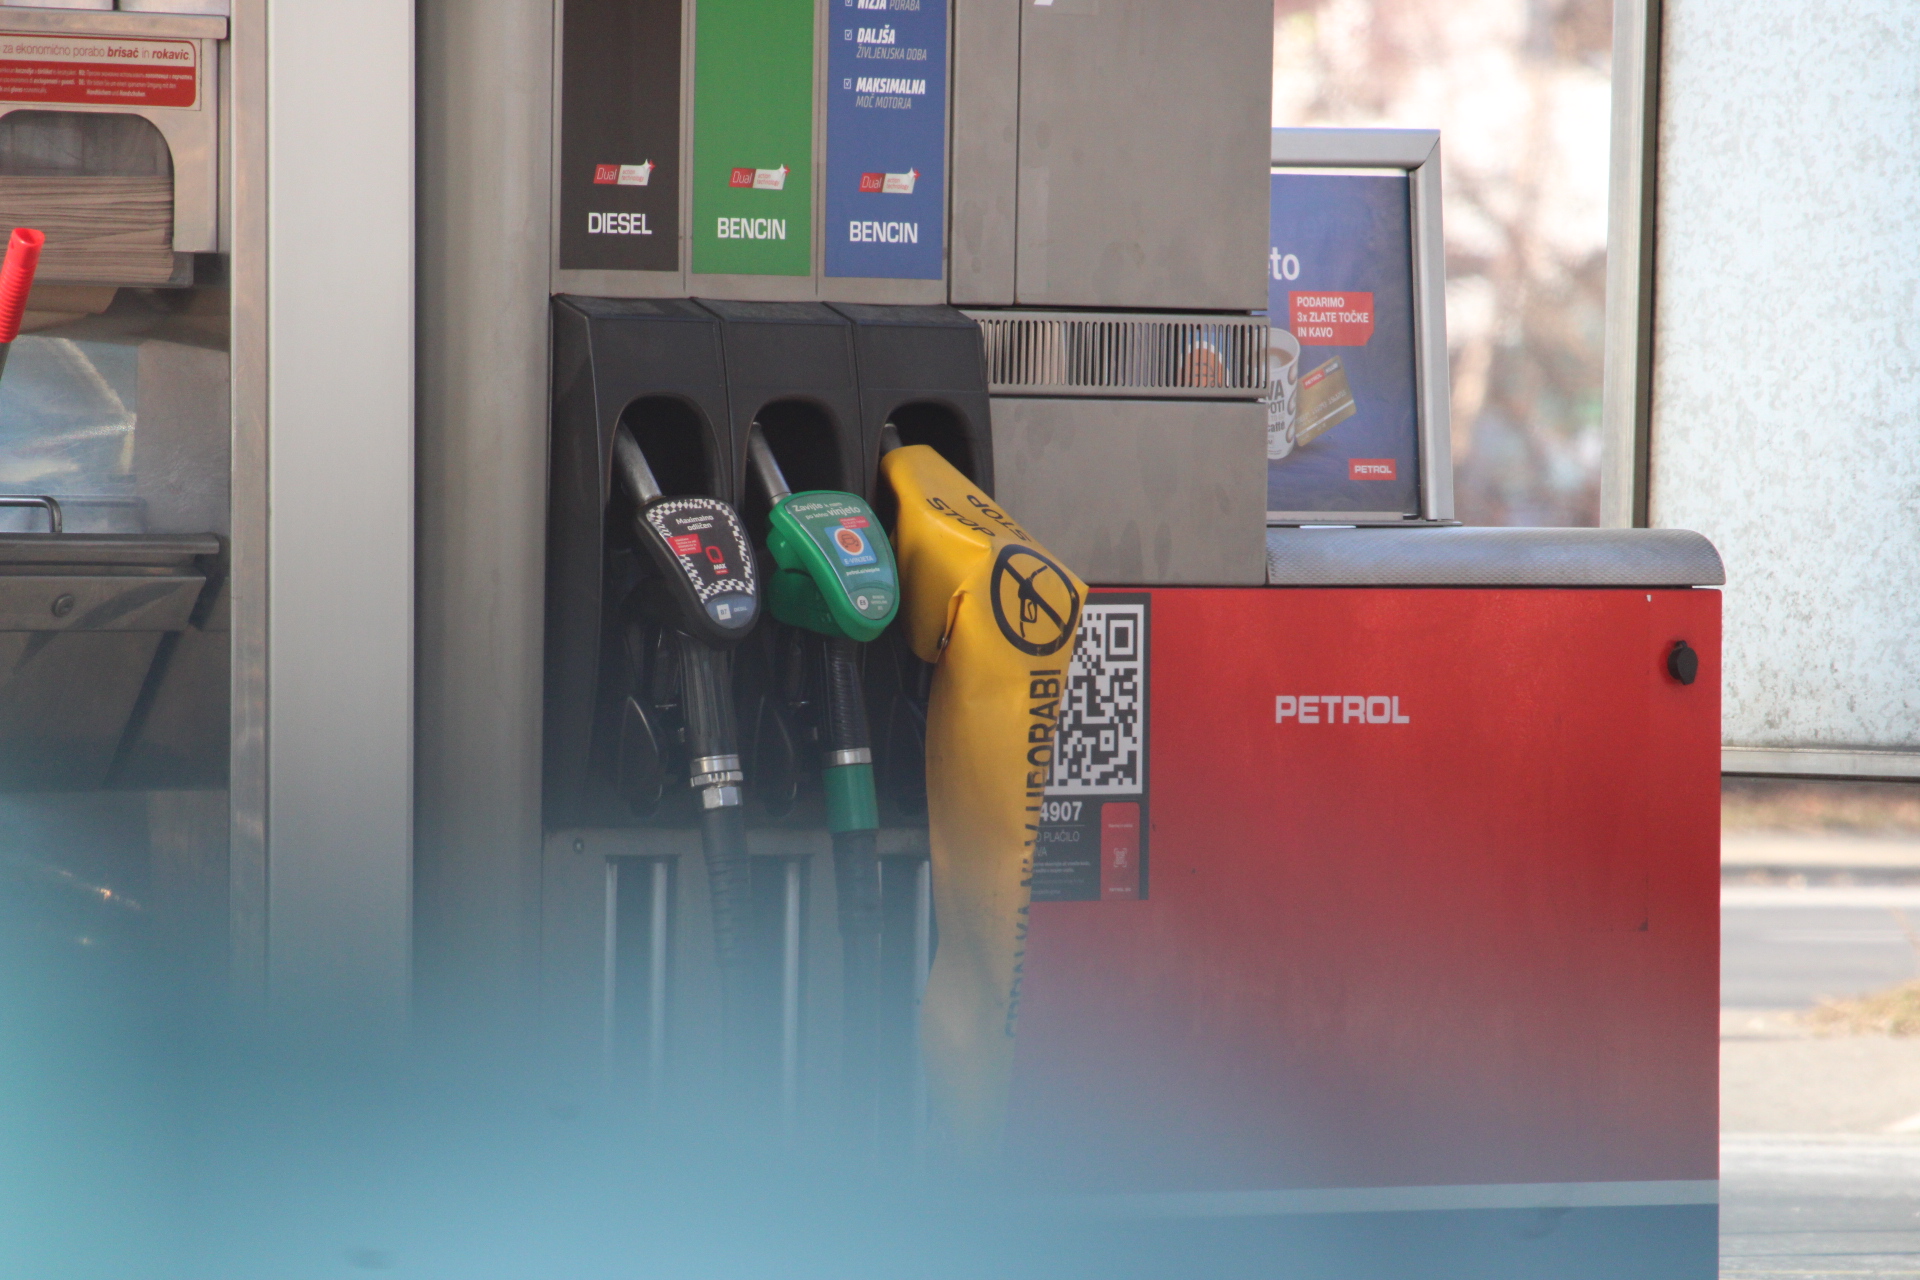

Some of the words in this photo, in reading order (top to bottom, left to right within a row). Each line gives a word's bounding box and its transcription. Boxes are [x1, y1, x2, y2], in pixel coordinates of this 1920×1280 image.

[889, 0, 920, 11] PORABA
[856, 24, 896, 44] DALJŠA
[3, 44, 14, 54] za
[16, 42, 71, 57] ekonomično
[73, 45, 105, 59] porabo
[107, 46, 139, 58] brisač
[141, 47, 150, 58] in
[855, 43, 905, 60] ŽIVLJENJSKA
[906, 48, 927, 61] DOBA
[855, 77, 926, 95] MAKSIMALNA
[855, 93, 875, 108] MOČ
[875, 96, 912, 109] MOTORJA
[596, 167, 618, 180] Dual
[732, 170, 753, 185] Dual
[861, 175, 883, 190] Dual
[588, 212, 653, 235] DIESEL
[717, 217, 786, 240] BENCIN
[849, 220, 918, 244] BENCIN
[1268, 246, 1300, 281] to
[1296, 296, 1345, 308] PODARIMO
[1297, 312, 1308, 323] 3x
[1309, 311, 1337, 323] ZLATE
[1338, 309, 1369, 323] TOČKE
[1297, 327, 1308, 338] IN
[1308, 327, 1333, 338] KAVO
[1268, 400, 1286, 415] OTI
[1354, 465, 1392, 474] PETROL
[792, 502, 823, 513] Zavijte
[827, 505, 861, 517] vinjeto
[675, 514, 715, 525] Maximalno
[926, 497, 996, 537] STOP
[966, 494, 1032, 543] STOP
[687, 521, 713, 532] odličen
[843, 555, 874, 565] E-VINJETA
[1275, 695, 1411, 724] PETROL
[1039, 801, 1083, 822] 4907
[1043, 828, 1080, 843] PLAČILO
